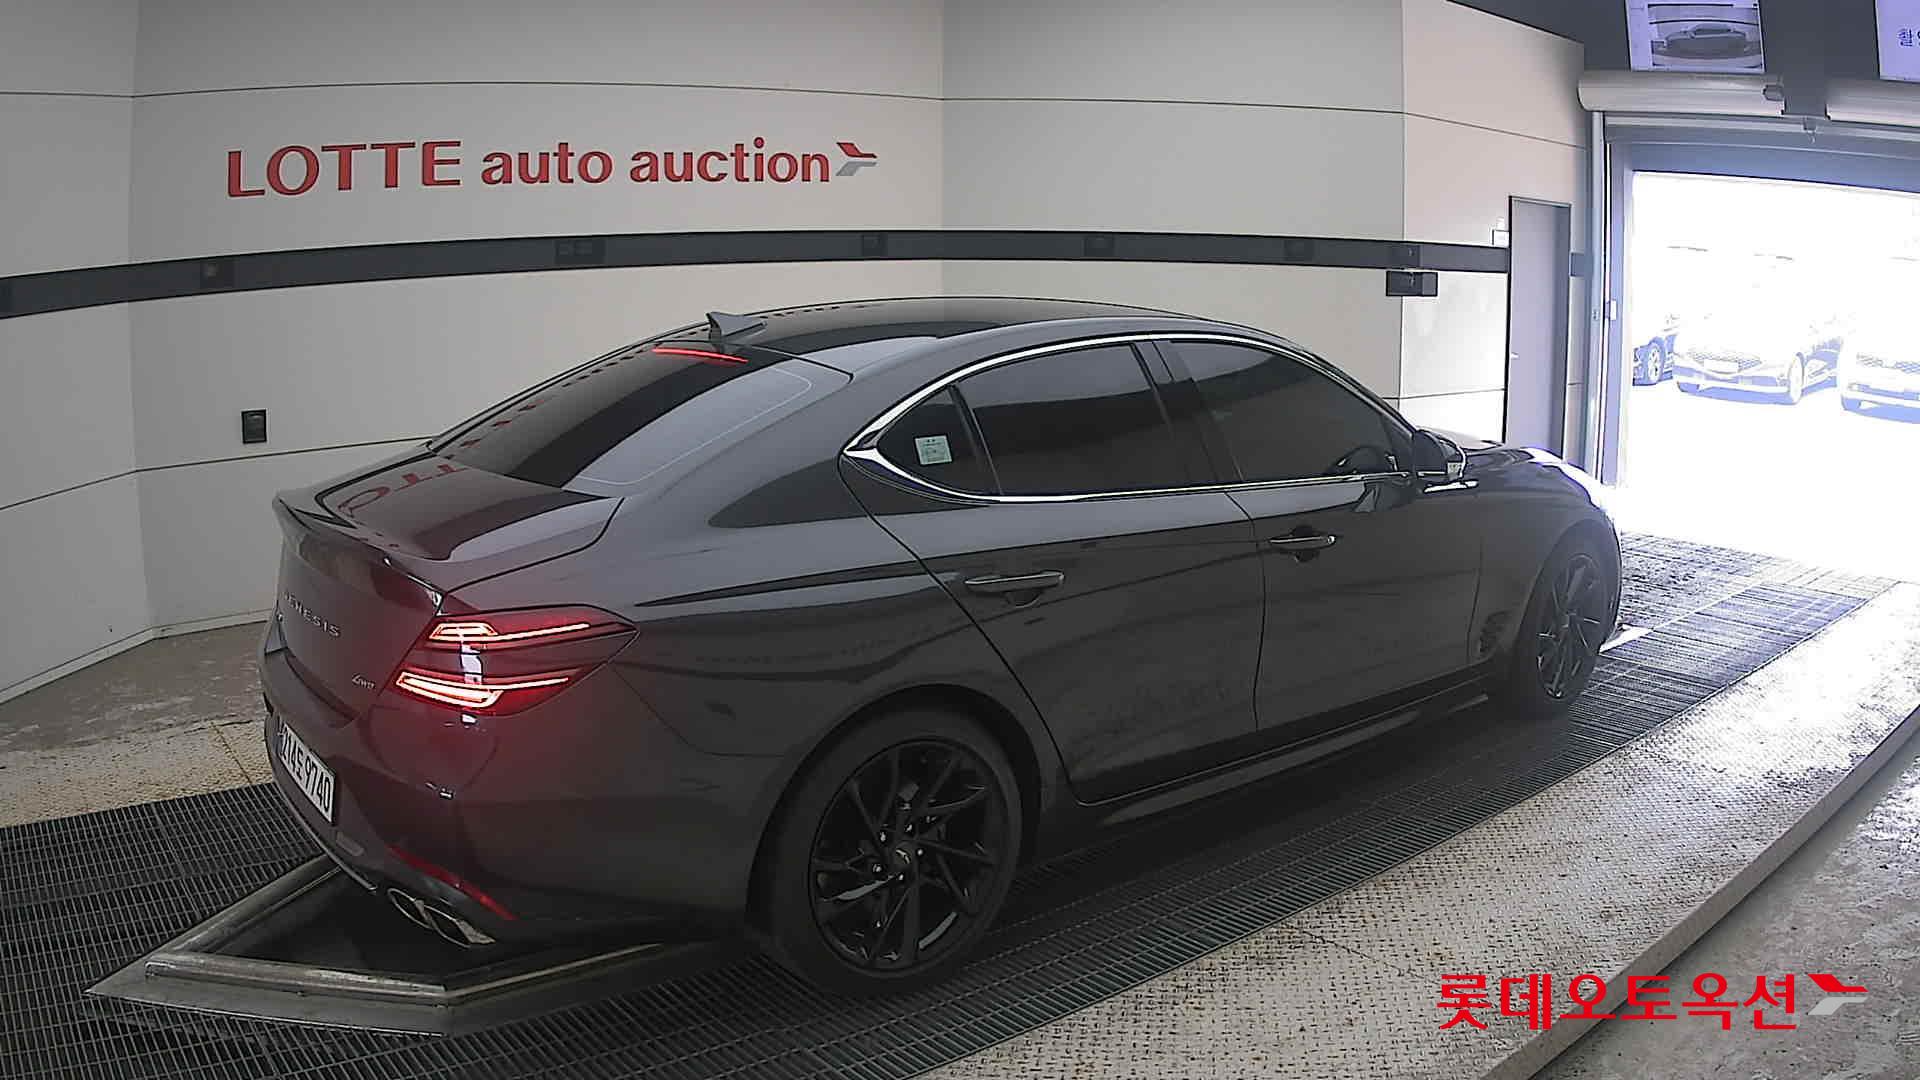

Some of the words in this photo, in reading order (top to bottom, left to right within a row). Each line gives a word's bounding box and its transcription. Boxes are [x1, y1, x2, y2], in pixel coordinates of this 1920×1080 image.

[228, 140, 461, 197] LOTTE
[481, 142, 613, 185] auto
[630, 136, 831, 183] auction
